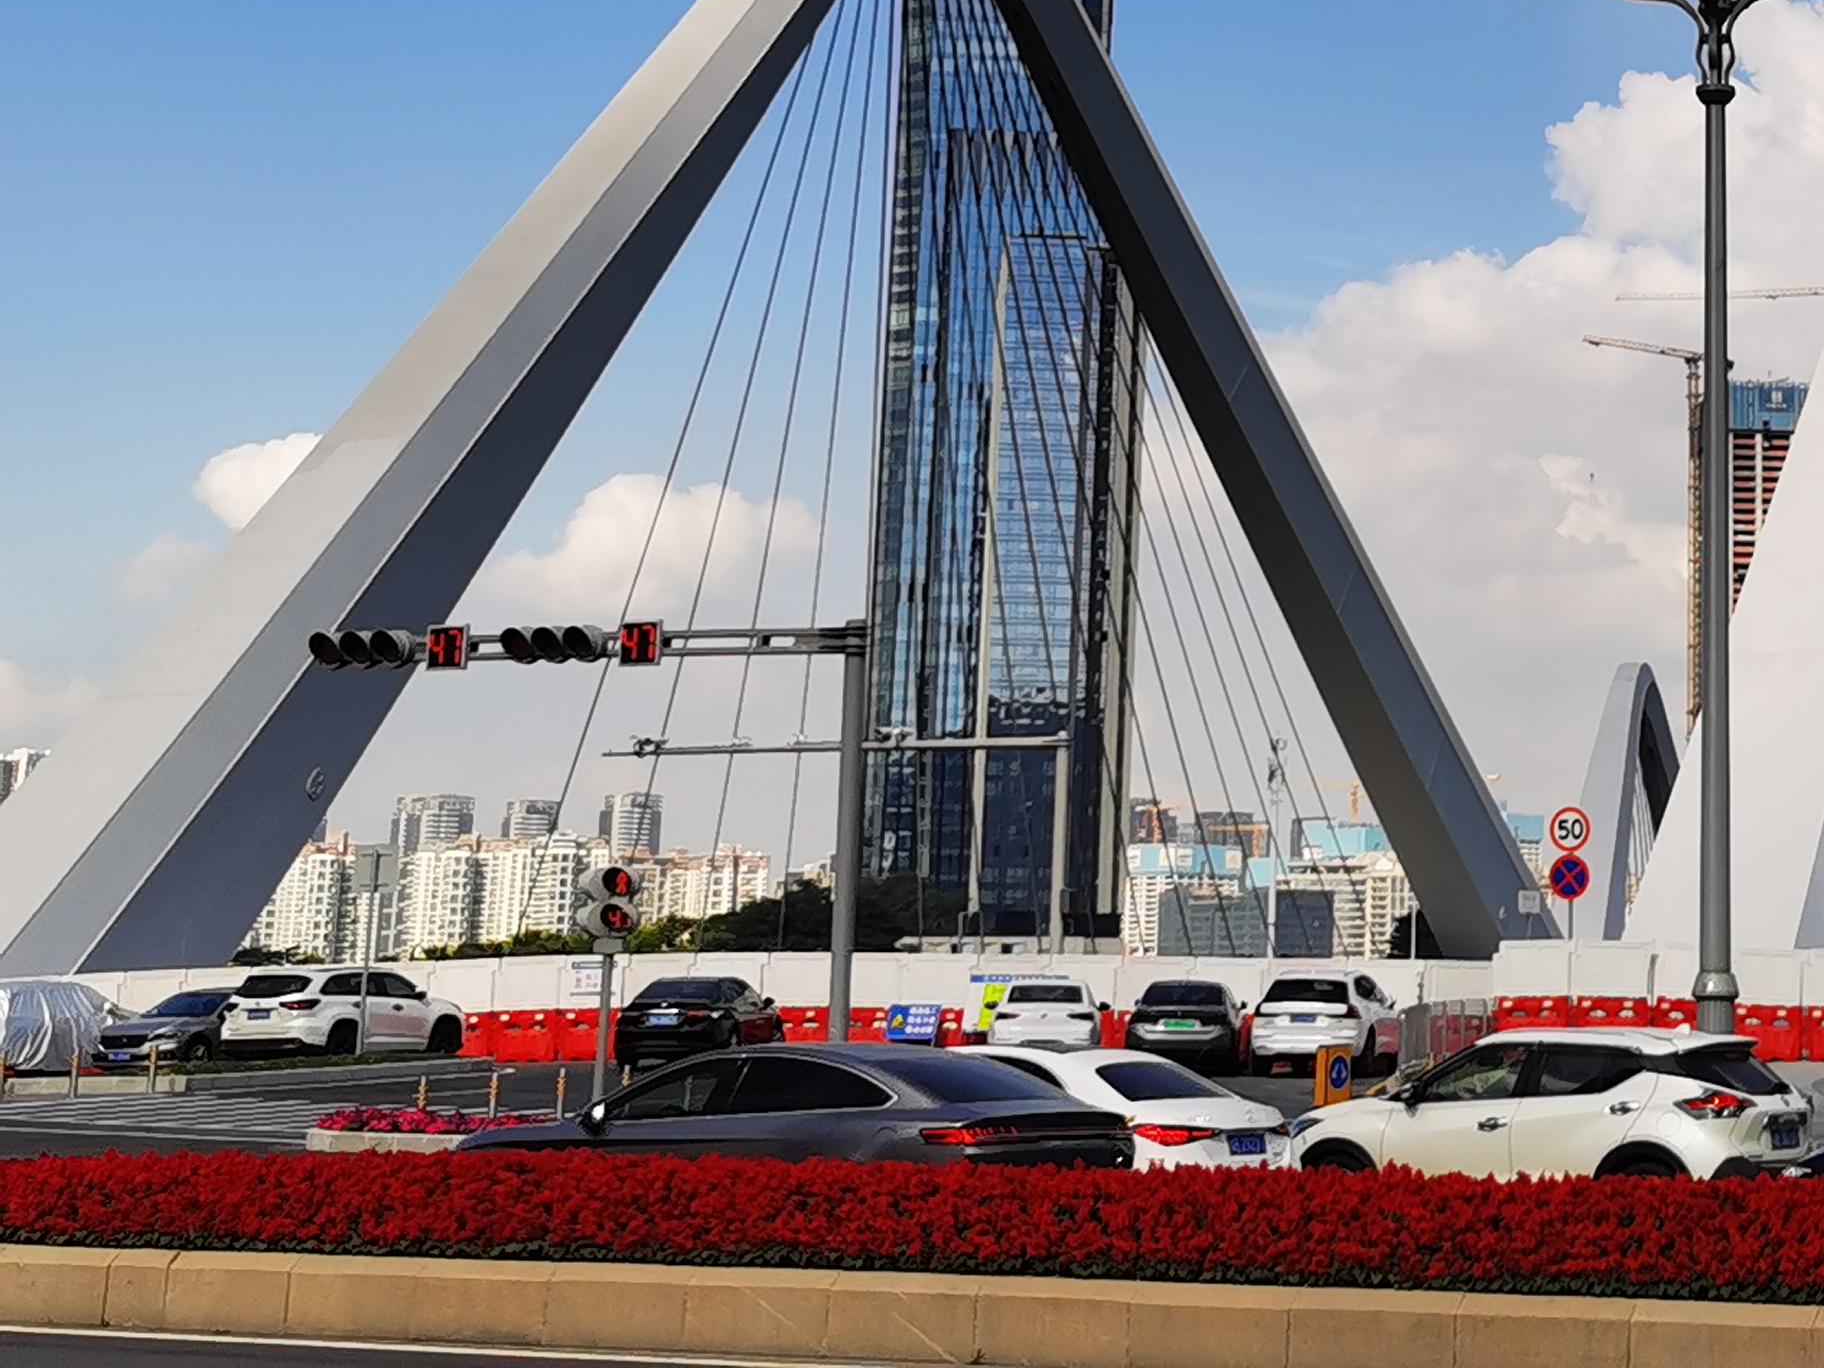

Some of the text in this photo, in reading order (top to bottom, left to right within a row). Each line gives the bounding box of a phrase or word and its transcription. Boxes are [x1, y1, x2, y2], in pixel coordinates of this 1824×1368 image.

[428, 630, 463, 664] 47
[620, 625, 656, 660] 47
[1558, 818, 1584, 840] 50
